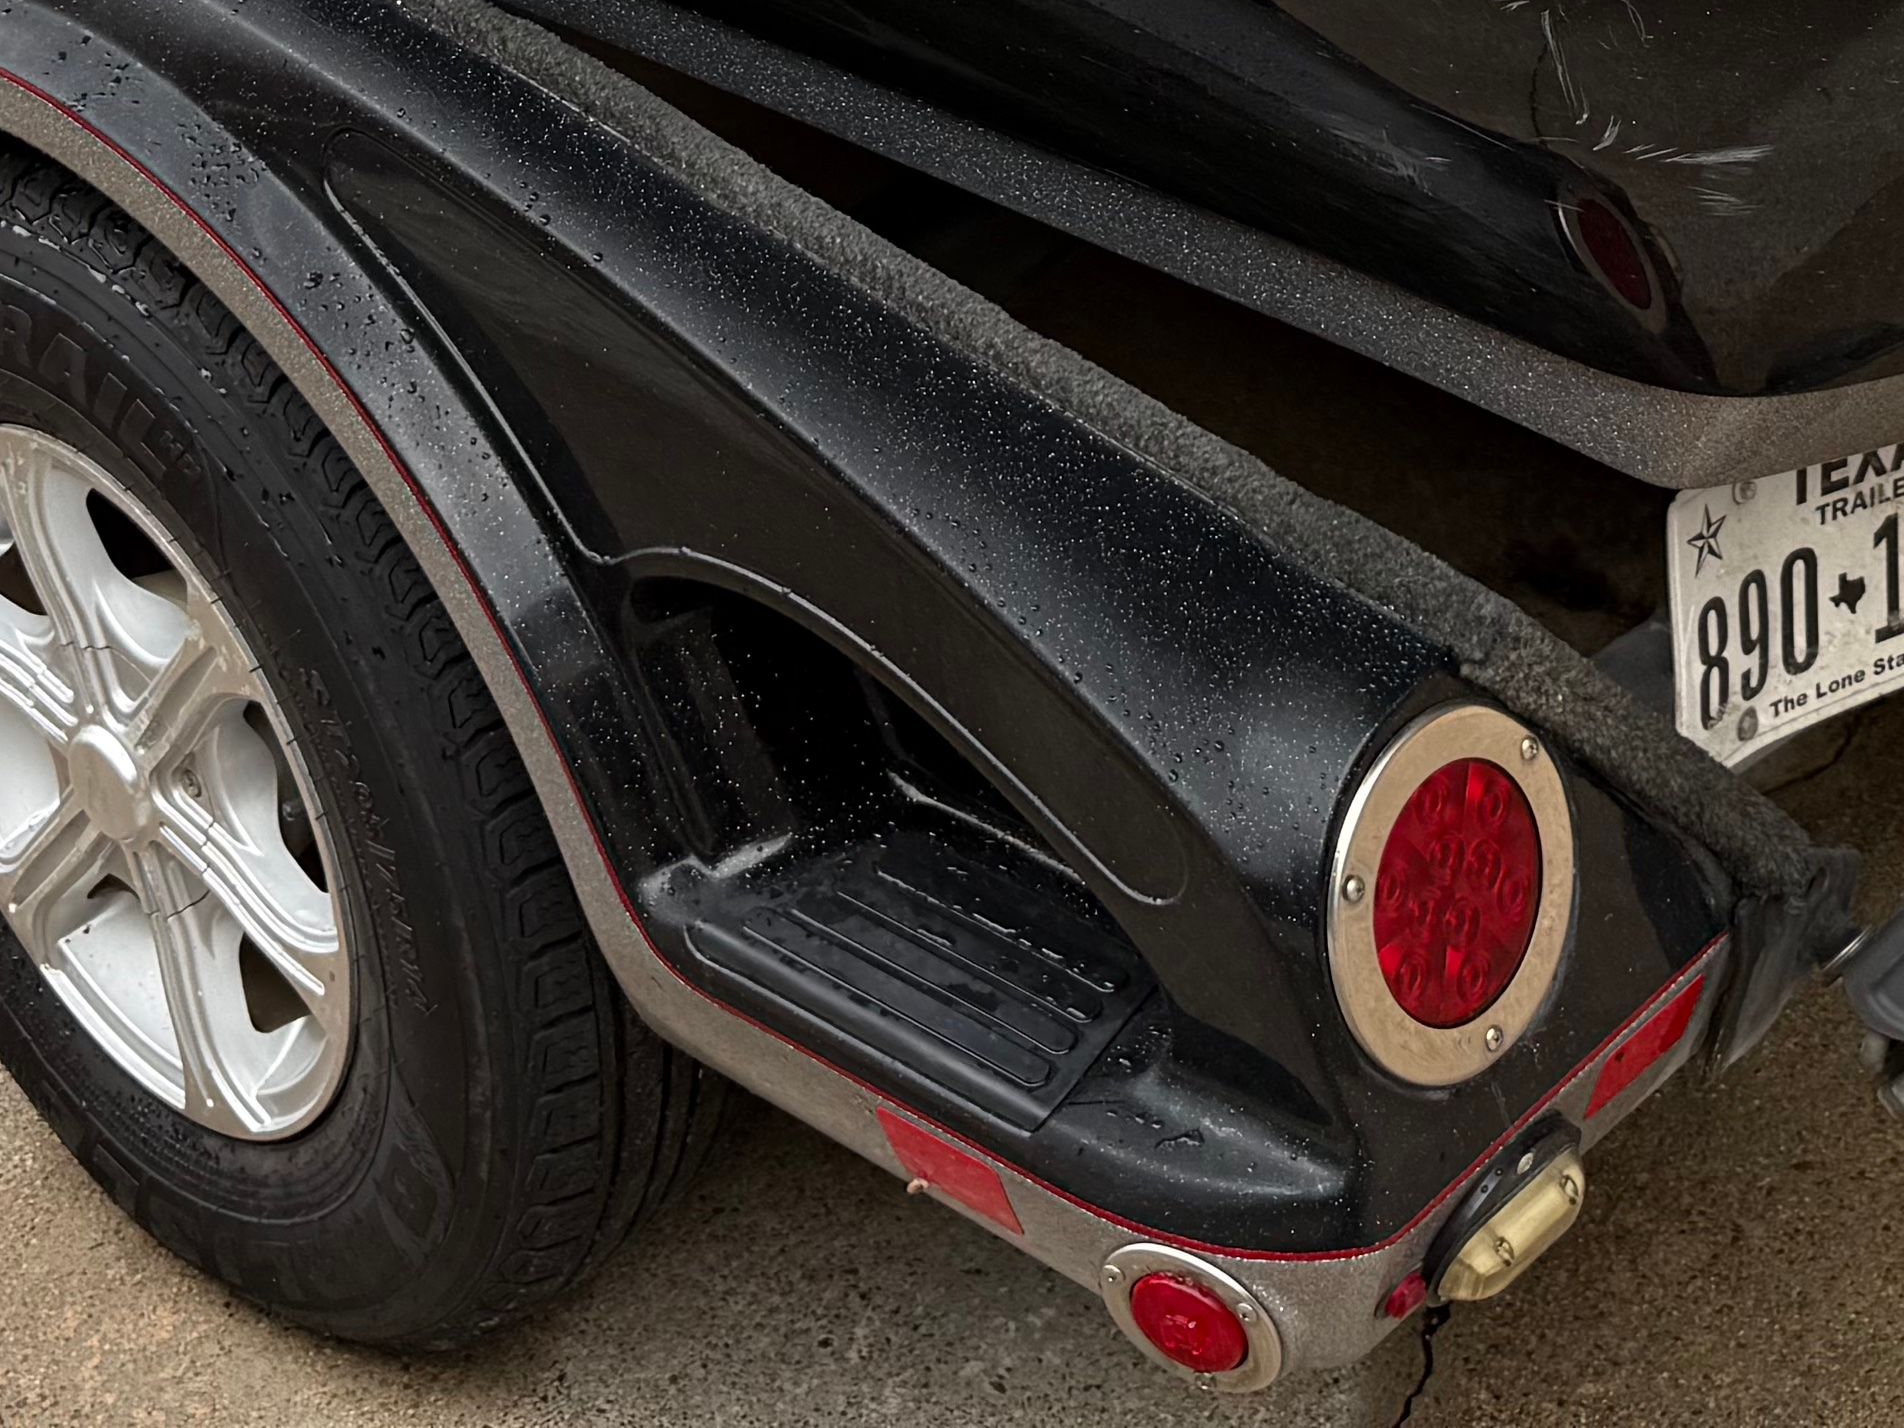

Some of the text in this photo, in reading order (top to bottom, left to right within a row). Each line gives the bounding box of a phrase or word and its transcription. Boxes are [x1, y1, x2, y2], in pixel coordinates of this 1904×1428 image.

[1697, 546, 1819, 731] 890
[1769, 689, 1808, 719] The
[1815, 670, 1865, 700] Lone
